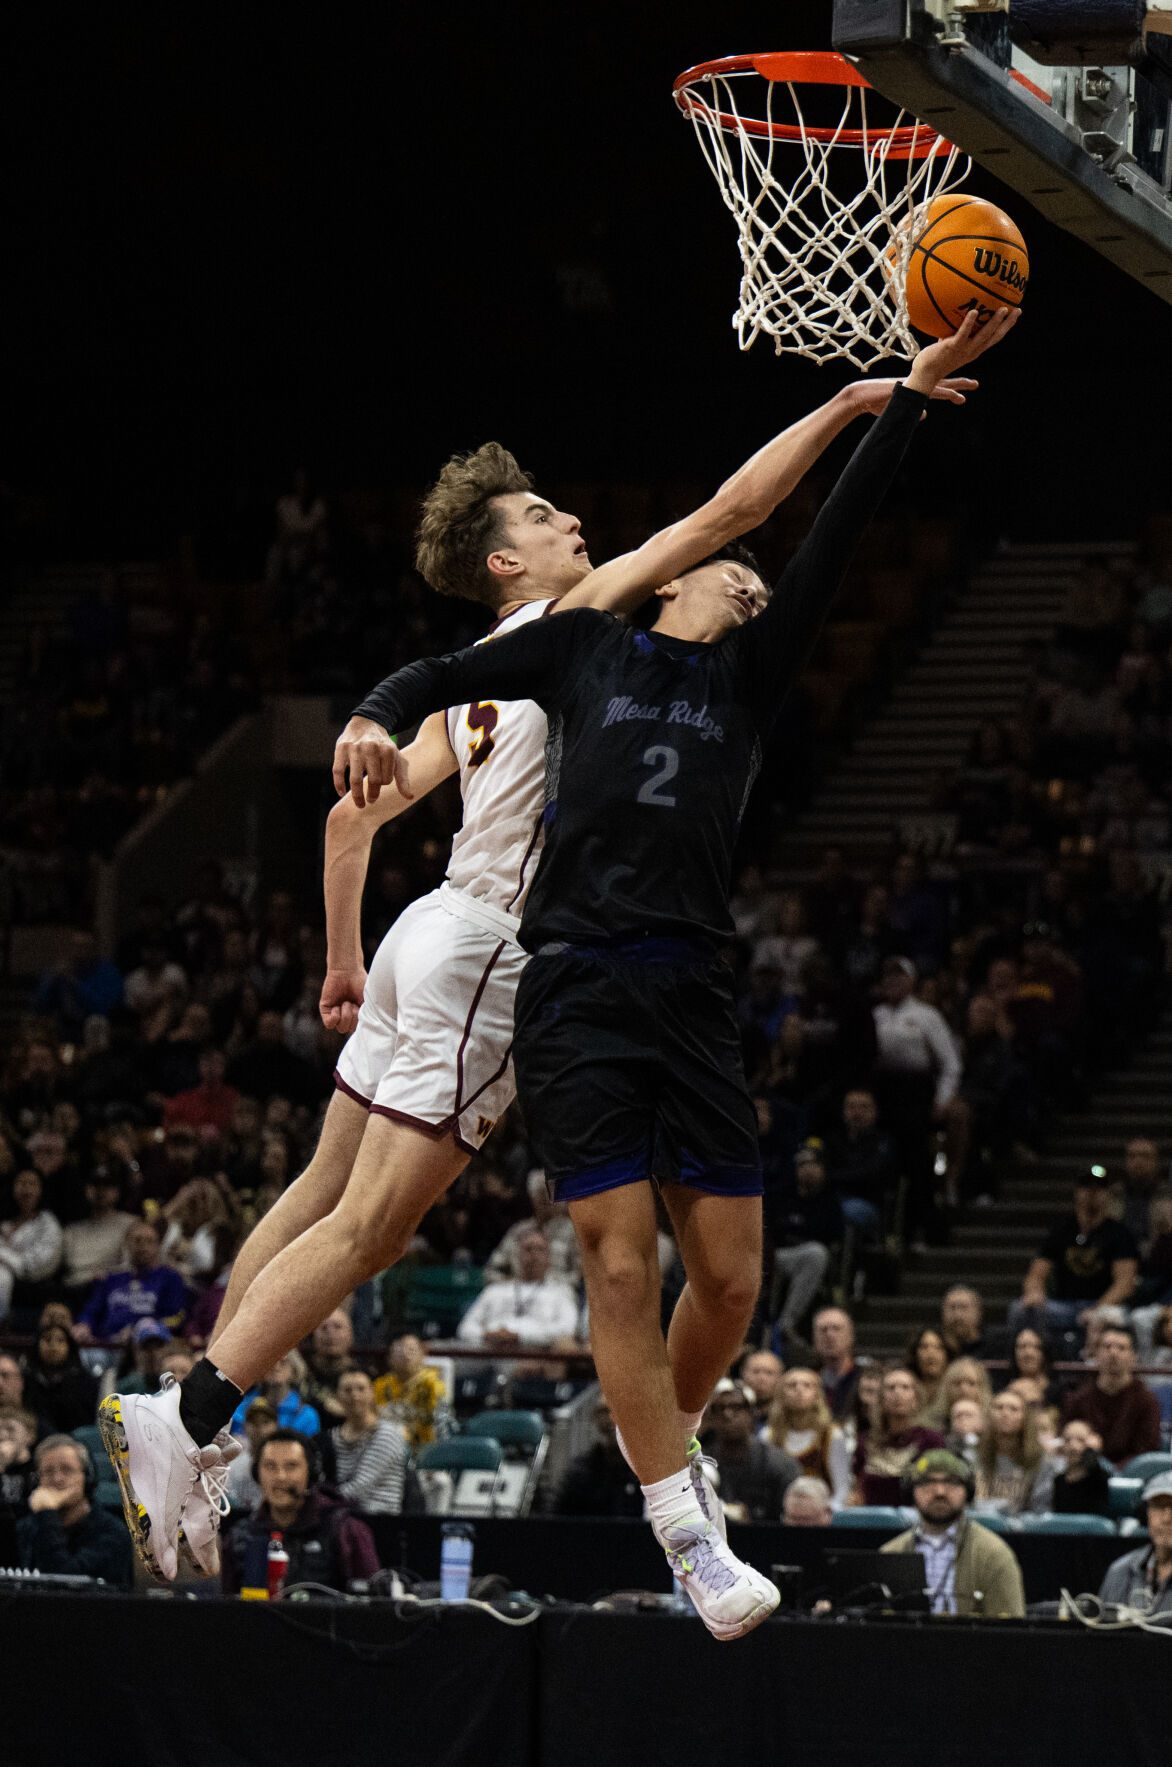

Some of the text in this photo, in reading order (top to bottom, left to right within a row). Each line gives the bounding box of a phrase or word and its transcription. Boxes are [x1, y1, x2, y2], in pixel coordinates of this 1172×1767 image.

[974, 247, 1026, 292] Wilso
[601, 695, 724, 743] Mesa Ridge
[637, 745, 679, 807] 2
